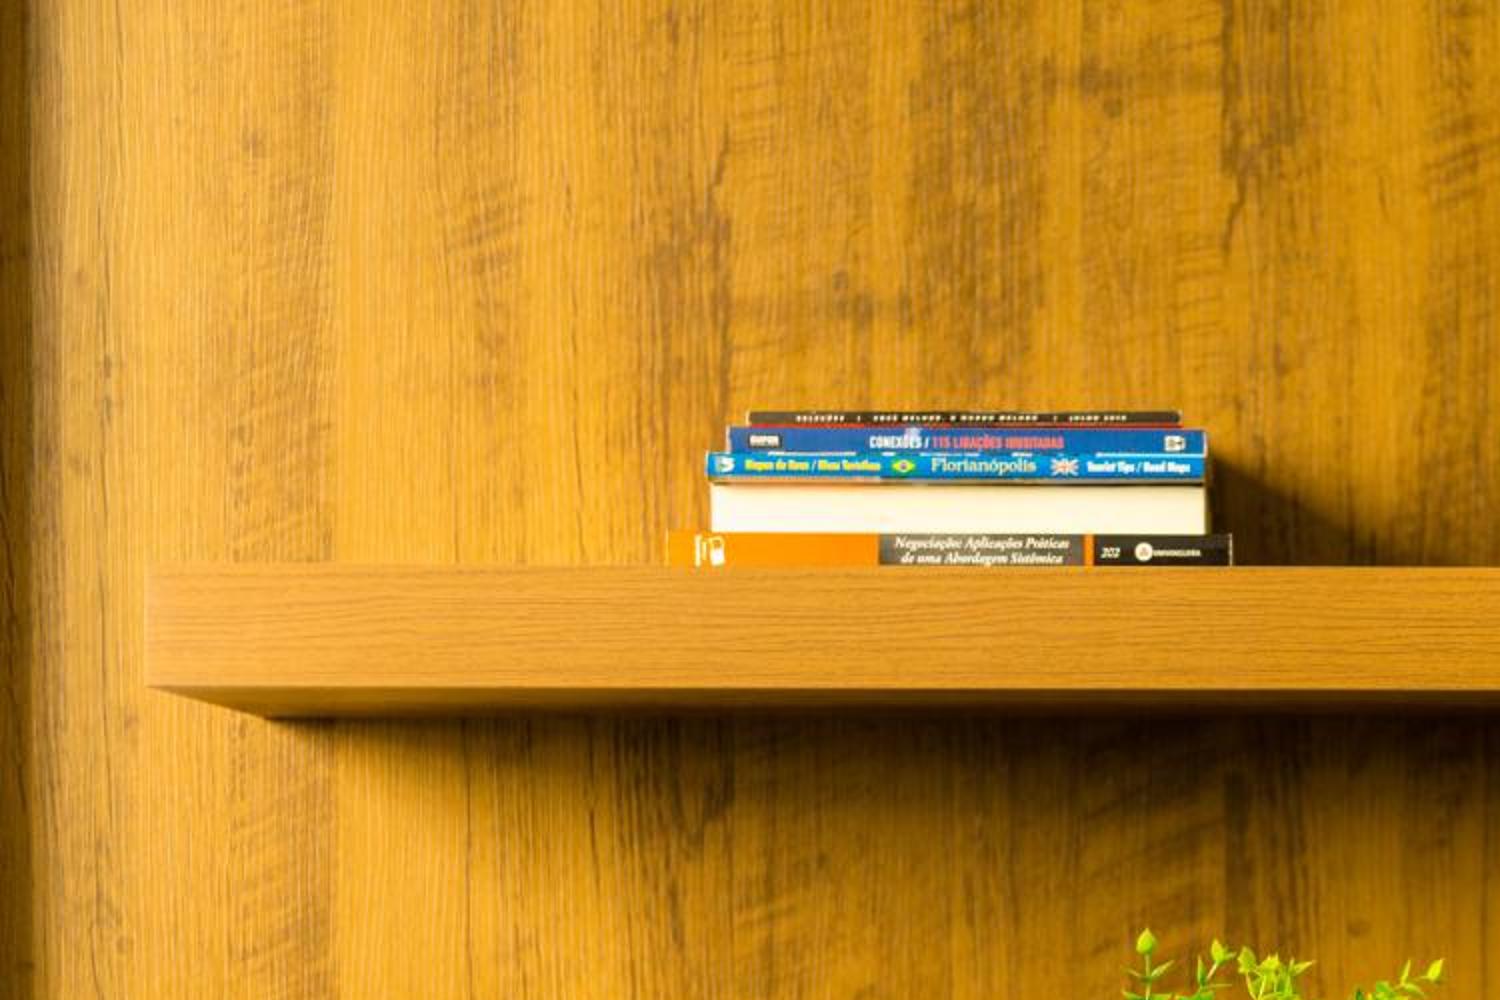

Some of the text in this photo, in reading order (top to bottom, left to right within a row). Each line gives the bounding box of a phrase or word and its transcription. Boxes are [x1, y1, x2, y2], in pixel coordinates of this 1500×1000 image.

[931, 456, 1037, 475] Florianópolis
[964, 535, 1023, 551] Aplicações
[1025, 536, 1071, 549] Práticas
[900, 551, 1064, 567] de uma Abordagem Sistêmica
